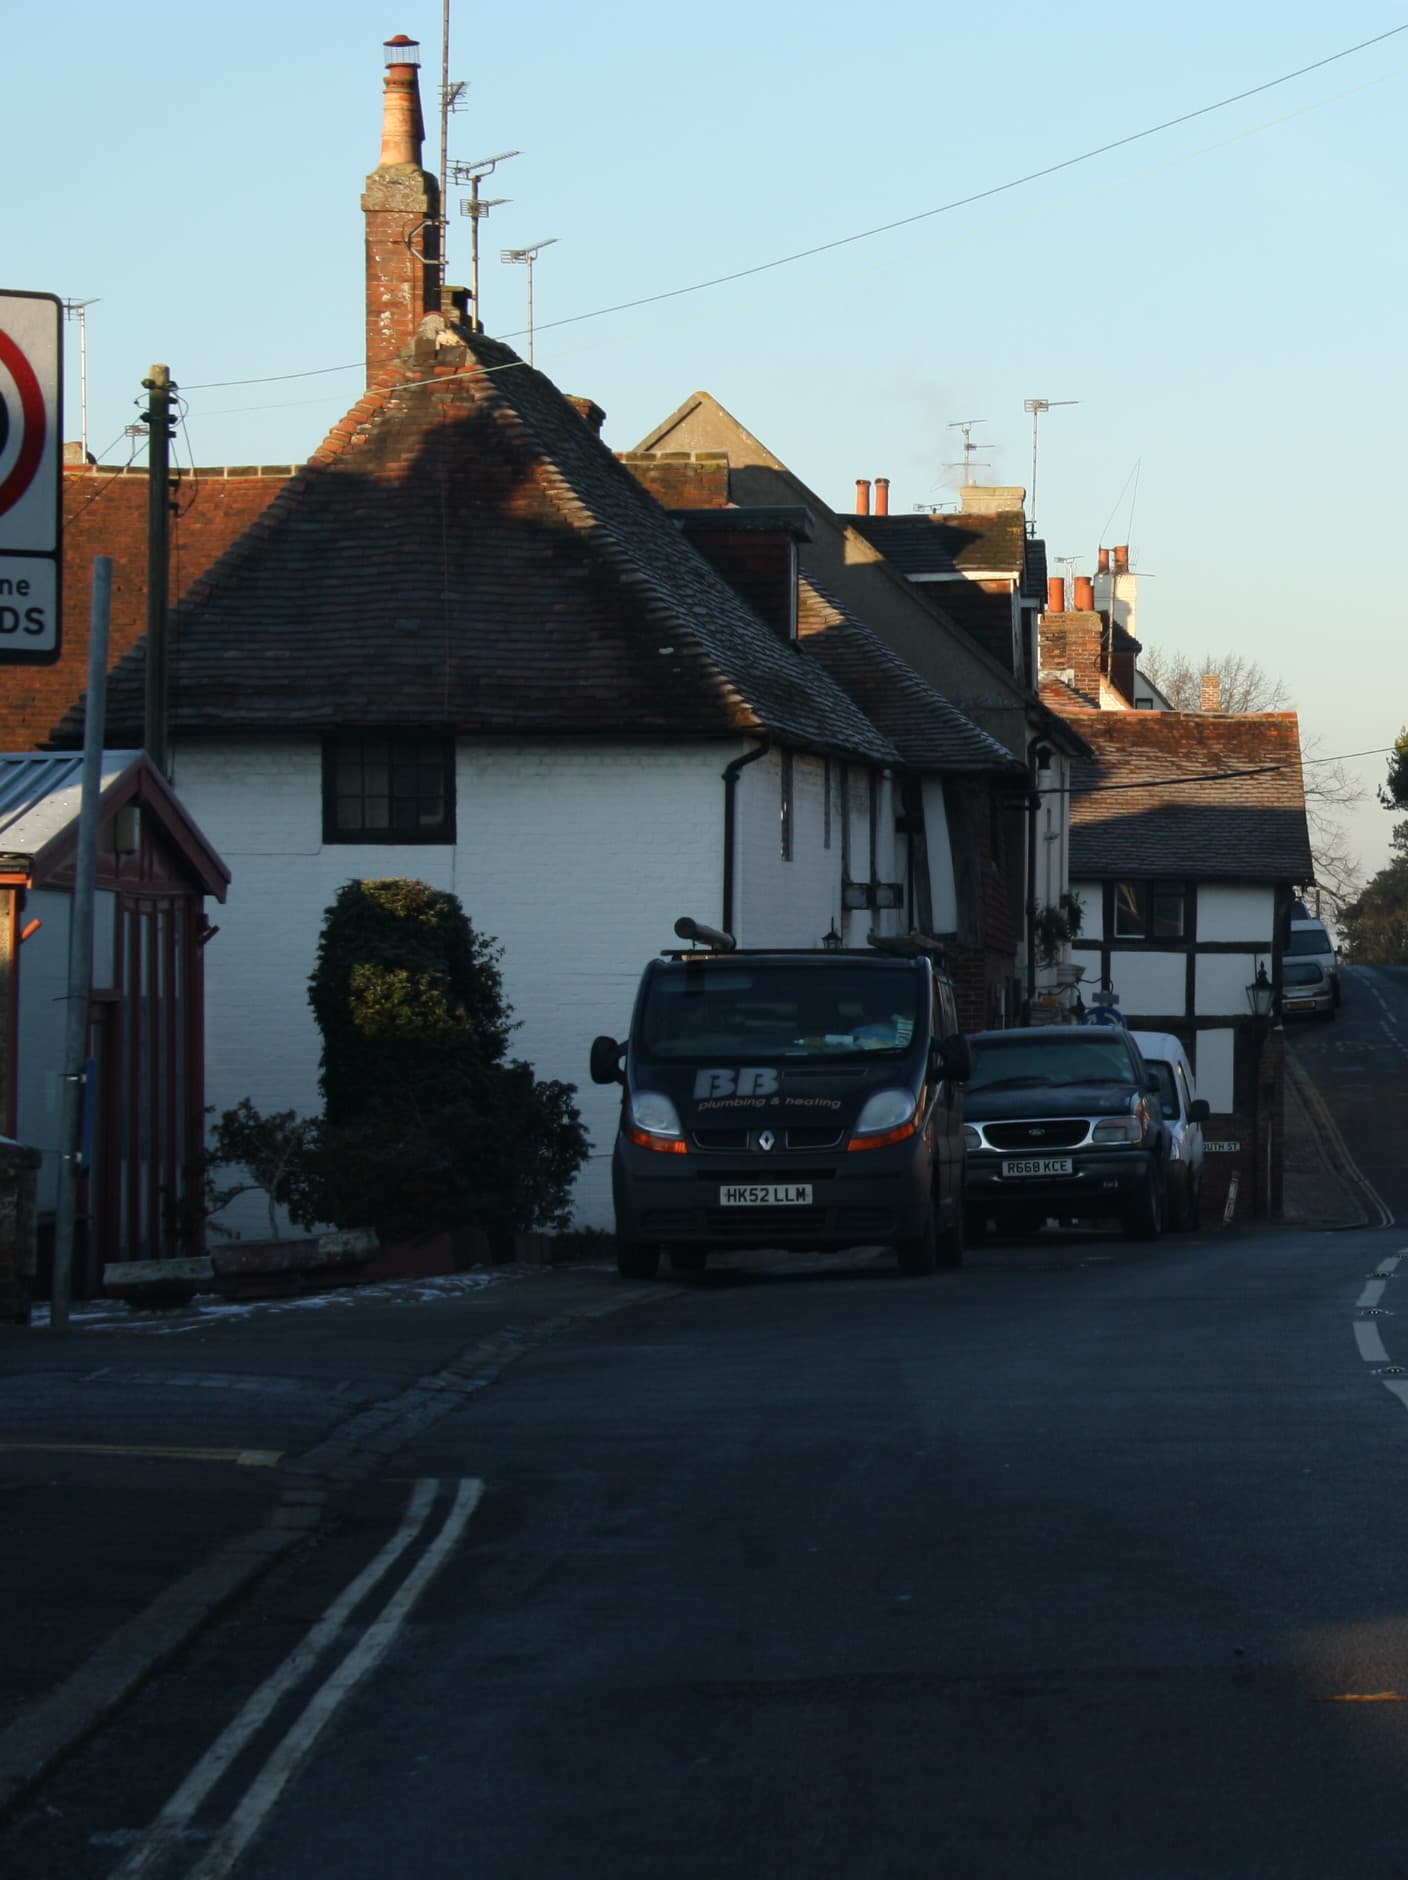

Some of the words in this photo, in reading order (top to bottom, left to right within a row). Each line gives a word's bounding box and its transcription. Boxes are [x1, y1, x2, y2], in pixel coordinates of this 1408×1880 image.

[692, 1066, 780, 1101] BB
[697, 1096, 767, 1112] plumbing
[770, 1096, 781, 1106] &
[1043, 1160, 1068, 1172] KCE
[727, 1187, 769, 1203] HK52
[774, 1186, 806, 1202] LLM
